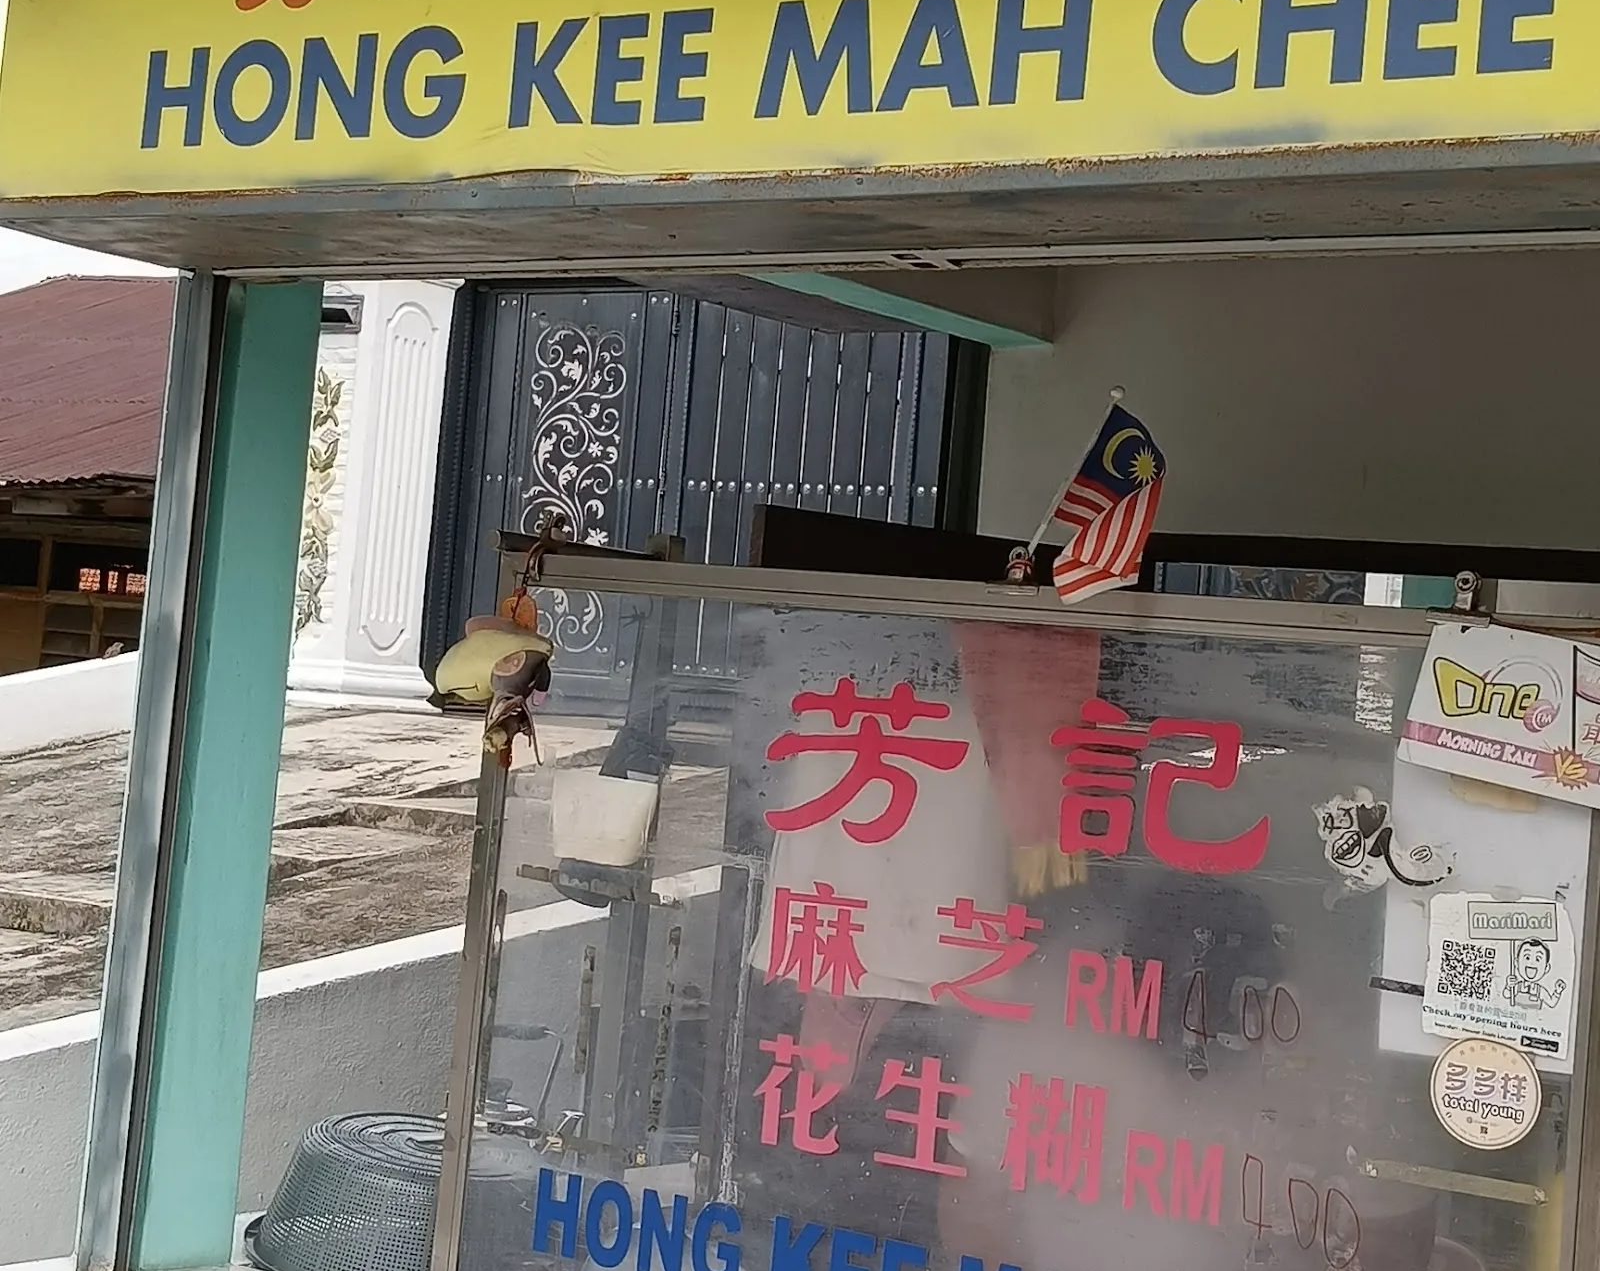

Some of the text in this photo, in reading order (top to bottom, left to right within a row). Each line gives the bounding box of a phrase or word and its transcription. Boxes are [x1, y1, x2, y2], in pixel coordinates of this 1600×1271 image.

[141, 26, 466, 149] HONG
[508, 8, 714, 129] KEE
[1433, 657, 1541, 719] One
[765, 678, 1270, 874] 芳記
[764, 882, 1044, 1021] 麻芝
[1064, 949, 1163, 1039] RM
[753, 1033, 1109, 1205] 花生糊
[1123, 1130, 1224, 1226] RM
[1442, 1093, 1479, 1113] total
[1480, 1103, 1525, 1125] young
